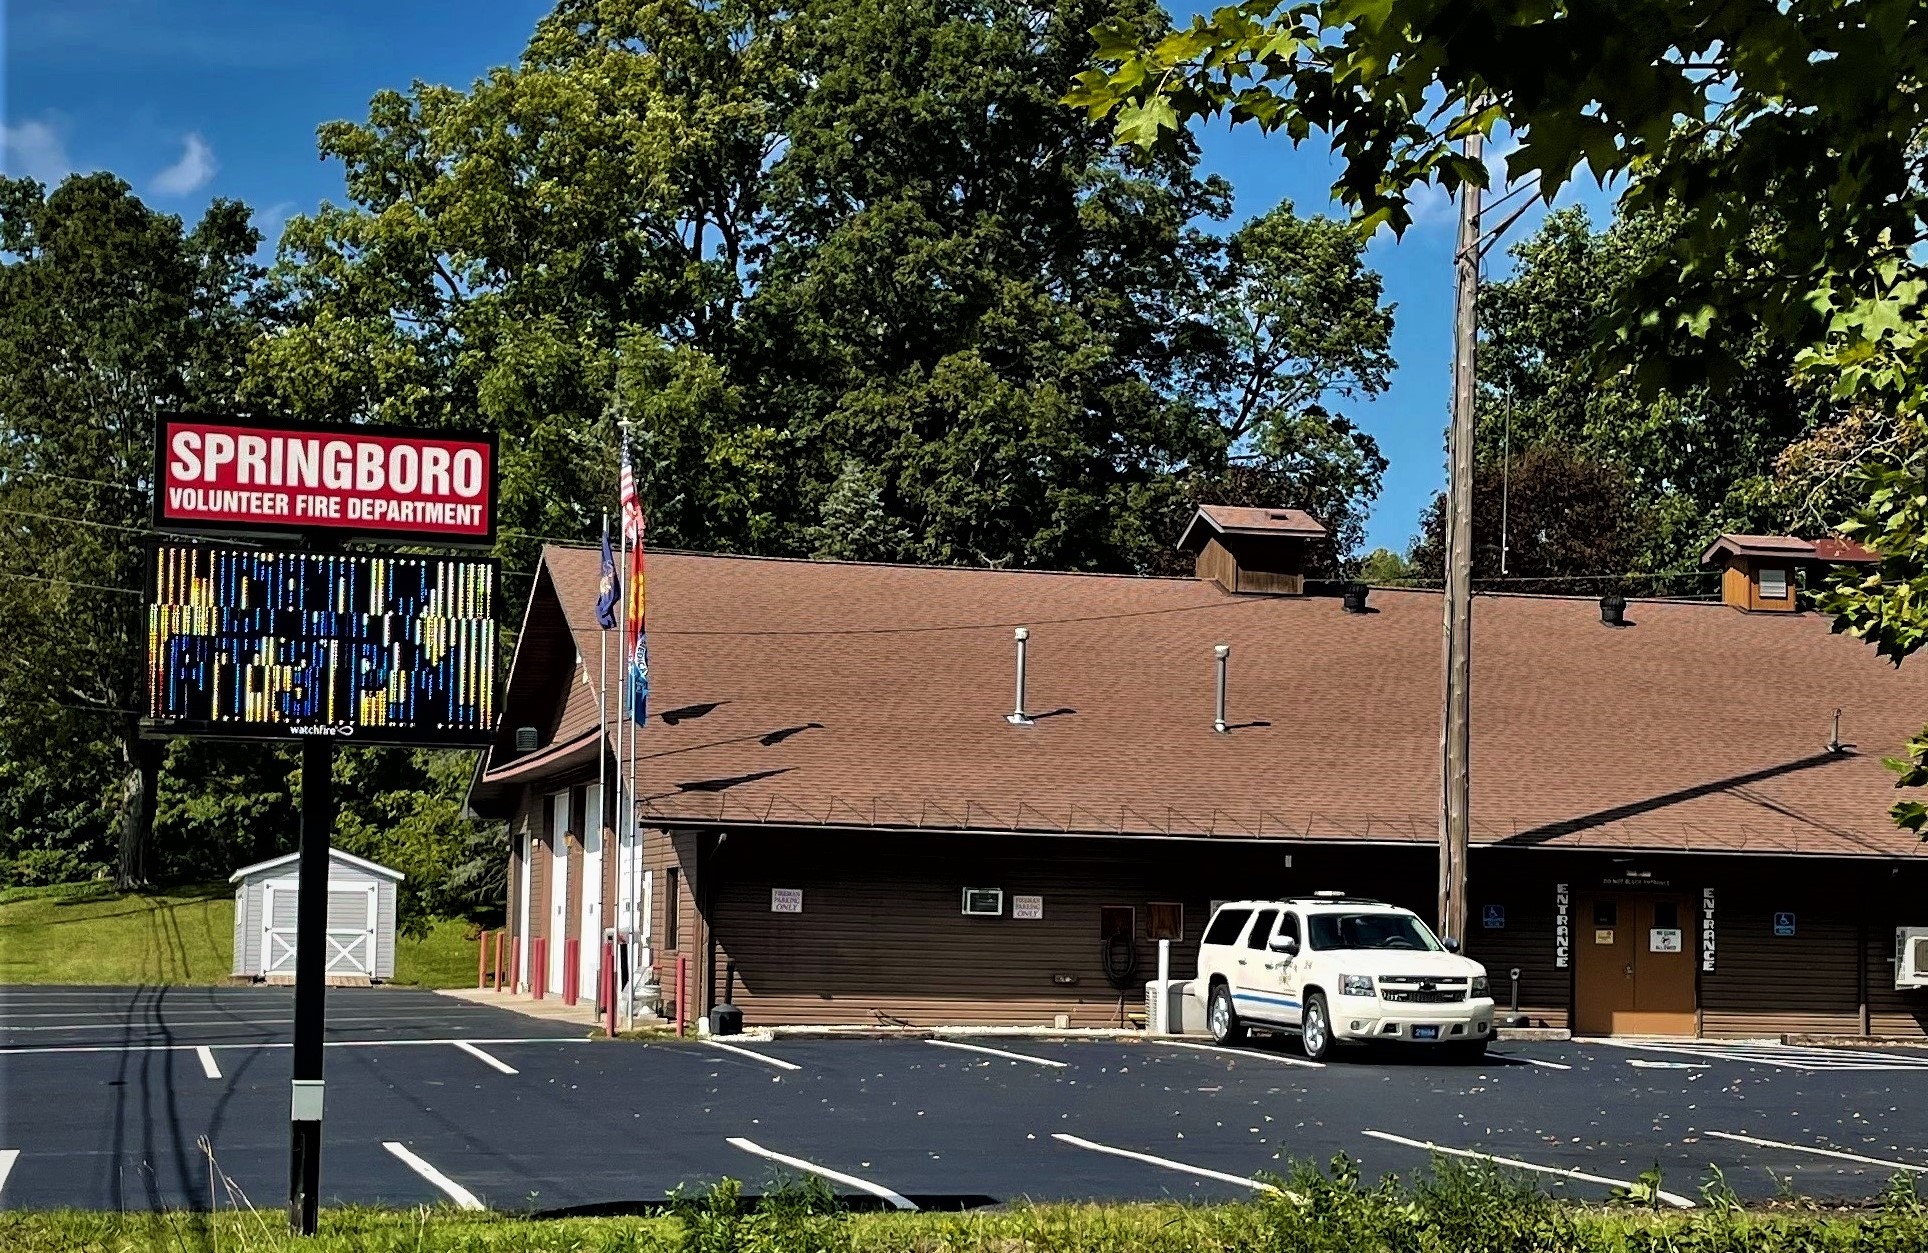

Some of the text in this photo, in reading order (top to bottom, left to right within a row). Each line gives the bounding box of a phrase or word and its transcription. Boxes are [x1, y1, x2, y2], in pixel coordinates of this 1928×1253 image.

[170, 430, 483, 498] SPRINGBORO
[168, 486, 483, 526] VOLUNTEER FIRE DEPARTMENT
[775, 903, 798, 911] ONLY
[1017, 909, 1040, 918] ONLY
[1556, 883, 1569, 968] ENTRANCE
[1702, 887, 1715, 972] ENTRANCE
